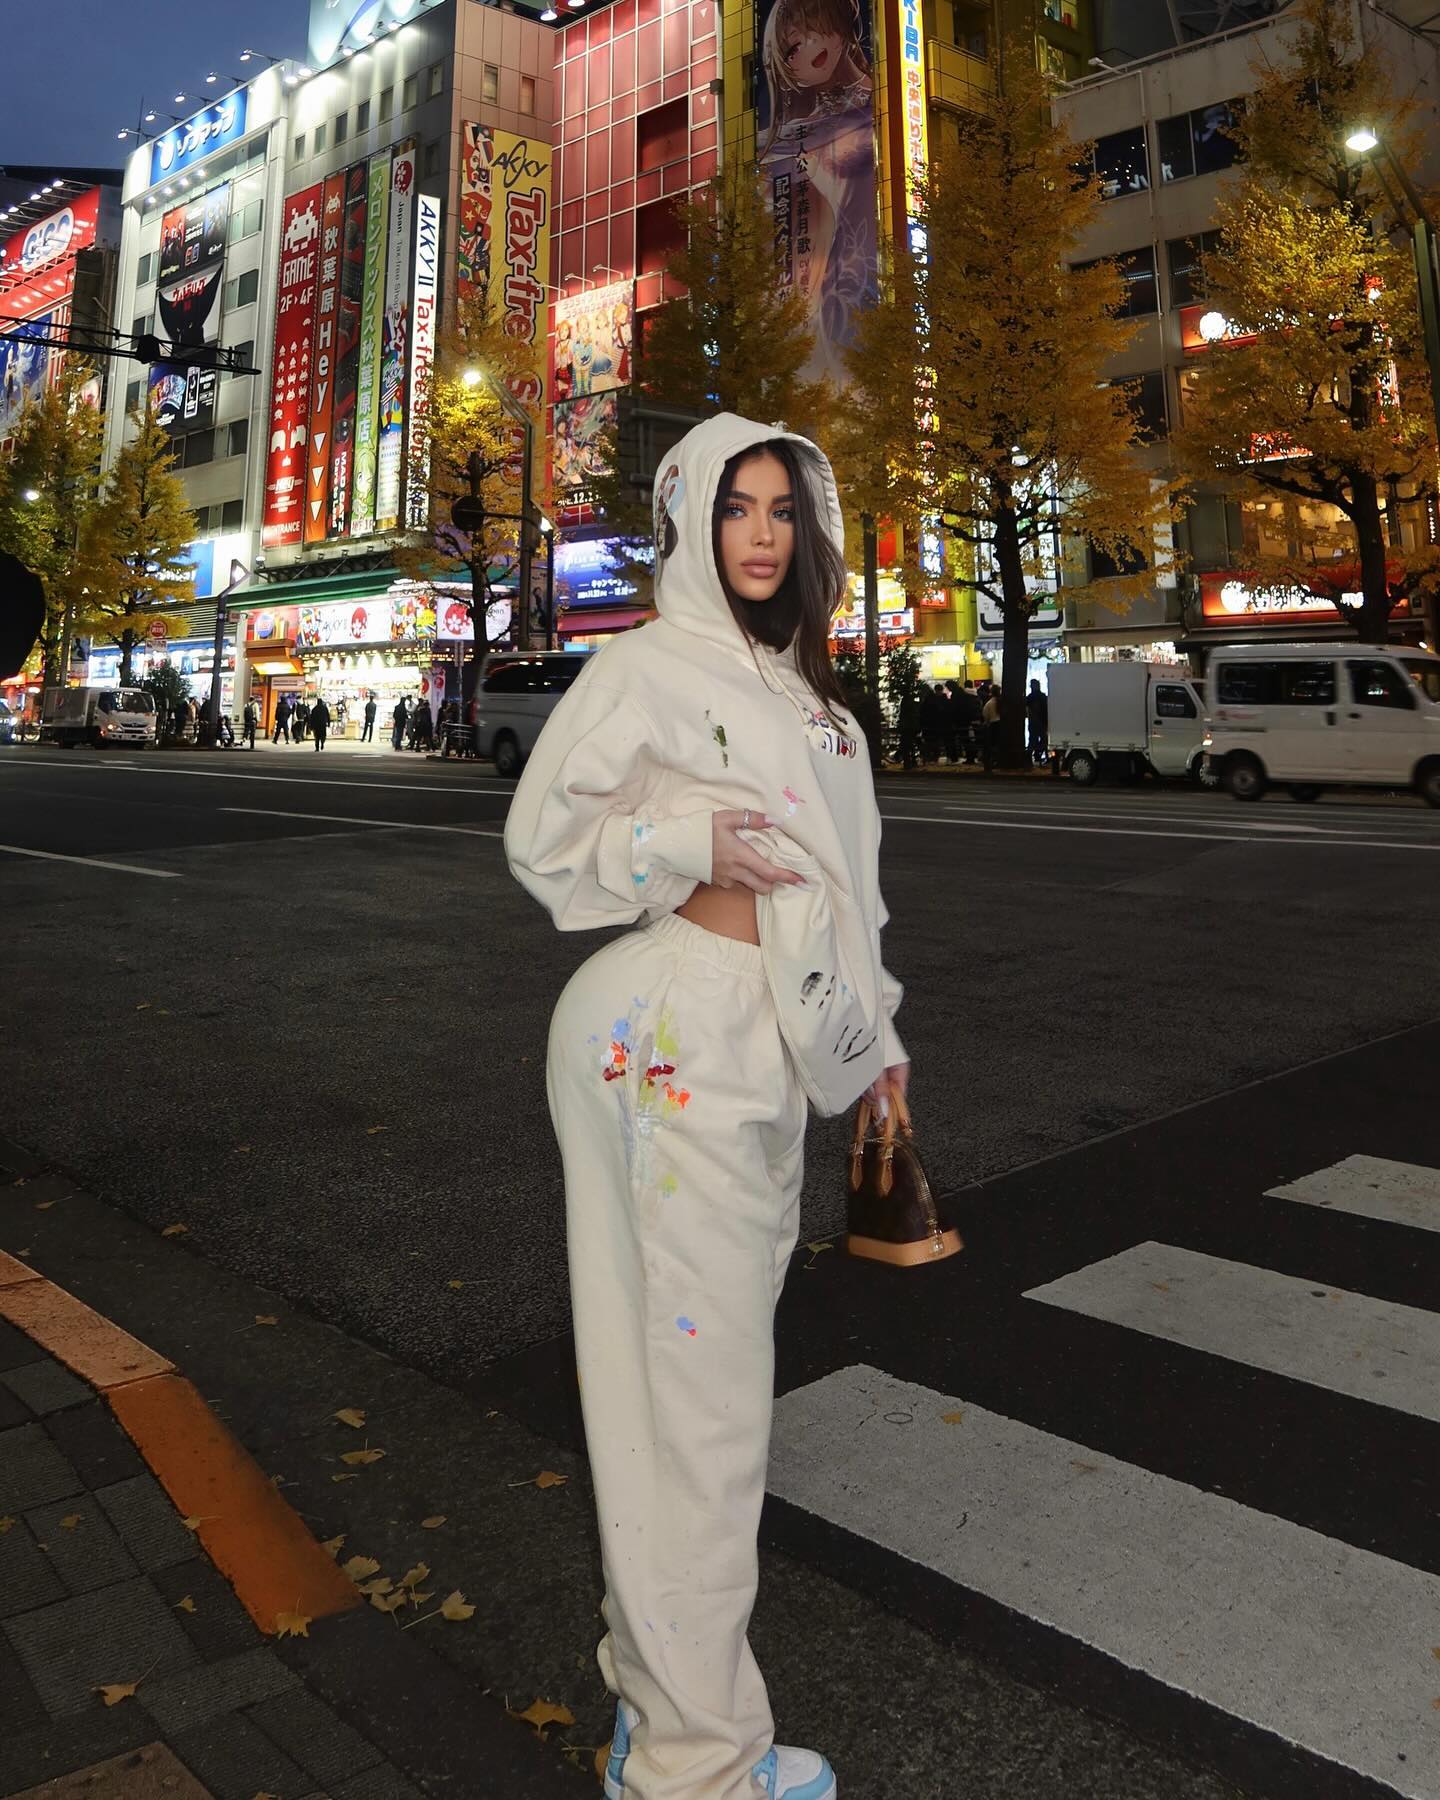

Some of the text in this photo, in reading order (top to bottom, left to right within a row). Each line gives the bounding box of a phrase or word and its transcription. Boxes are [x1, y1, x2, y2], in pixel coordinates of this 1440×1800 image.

[282, 252, 315, 288] GAME
[419, 201, 436, 271] AKKY
[414, 294, 433, 394] Tax-free
